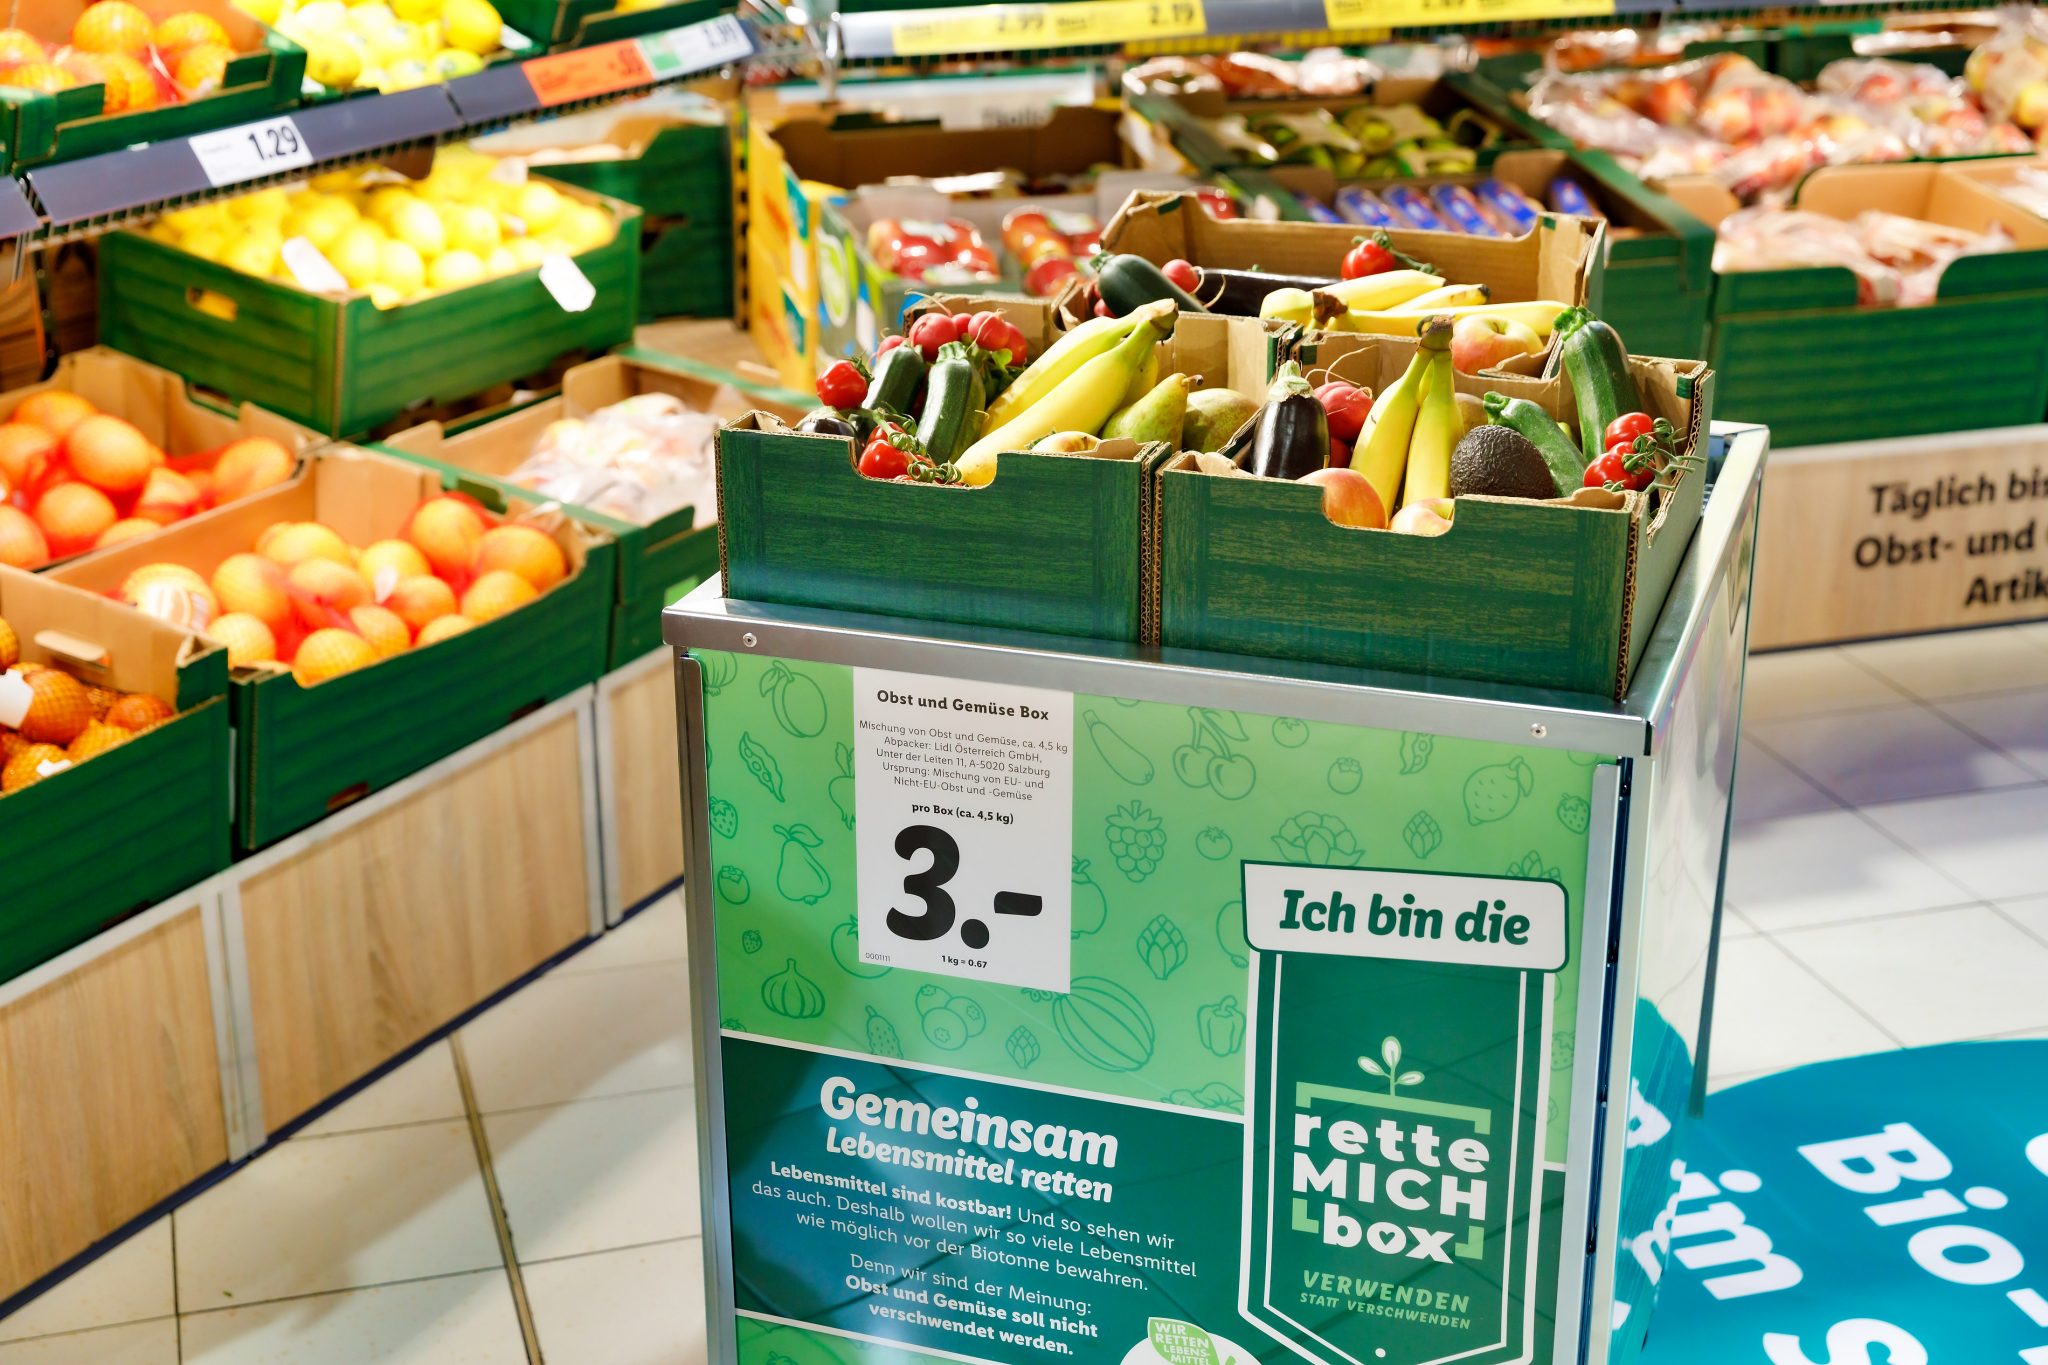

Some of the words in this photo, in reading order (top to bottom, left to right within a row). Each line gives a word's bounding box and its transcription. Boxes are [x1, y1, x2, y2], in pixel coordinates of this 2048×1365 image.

[248, 126, 298, 160] 1.29
[1871, 474, 1995, 519] Täglich
[1854, 533, 1955, 569] Obst-
[1967, 518, 2036, 556] und
[877, 690, 913, 706] Obst
[918, 697, 948, 710] und
[952, 698, 1015, 717] Gemüse
[1020, 705, 1048, 720] Box
[859, 720, 906, 736] Mischung
[908, 728, 926, 736] von
[929, 728, 952, 739] Obst
[955, 733, 974, 742] und
[977, 733, 1020, 747] Gemüse,
[1022, 740, 1036, 749] ca.
[1038, 741, 1053, 751] 4,5
[1056, 742, 1068, 754] kg
[884, 736, 931, 750] Abpacker:
[934, 742, 952, 752] Lidl
[954, 742, 1005, 758] Österreich
[876, 747, 902, 760] Unter
[905, 752, 921, 762] der
[924, 754, 953, 765] Leiten
[956, 757, 967, 768] 11,
[969, 759, 1005, 771] A-5020
[1008, 763, 1050, 779] Salzburg
[882, 761, 930, 778] Ursprung:
[933, 768, 980, 784] Mischung
[983, 776, 1001, 784] von
[1004, 776, 1021, 786] EU-
[1025, 780, 1044, 789] und
[894, 776, 964, 793] Nicht-EU-Obst
[966, 787, 986, 796] und
[989, 788, 1032, 801] -Gemüse
[912, 804, 930, 813] pro
[933, 805, 953, 816] Box
[956, 807, 975, 818] (ca.
[977, 811, 993, 821] 4,5
[996, 812, 1014, 824] kg)
[1279, 889, 1356, 933] Ich
[1368, 893, 1443, 939] bin
[1455, 899, 1530, 945] die
[948, 956, 959, 966] kg
[968, 959, 987, 968] 0.67
[820, 1076, 1118, 1168] Gemeinsam
[1294, 1113, 1490, 1173] rette
[827, 1127, 1014, 1185] Lebensmittel
[1021, 1168, 1112, 1203] retten
[1293, 1152, 1487, 1221] MICH
[771, 1161, 887, 1196] Lebensmittel
[892, 1184, 931, 1205] sind
[936, 1192, 1011, 1220] kostbar!
[1018, 1207, 1055, 1228] Und
[1061, 1219, 1081, 1232] so
[1087, 1223, 1140, 1243] sehen
[1147, 1234, 1175, 1249] wir
[752, 1180, 781, 1198] das
[787, 1190, 831, 1207] auch.
[836, 1195, 905, 1222] Deshalb
[910, 1214, 967, 1234] wollen
[973, 1225, 1000, 1240] wir
[1006, 1231, 1026, 1244] so
[1032, 1235, 1073, 1253] viele
[1080, 1241, 1197, 1277] Lebensmittel
[1323, 1202, 1455, 1264] box
[797, 1213, 825, 1228] wie
[831, 1220, 898, 1243] möglich
[903, 1235, 931, 1249] vor
[936, 1238, 964, 1256] der
[970, 1243, 1049, 1272] Biotonne
[1056, 1259, 1148, 1290] bewahren.
[845, 1275, 889, 1297] Obst
[893, 1287, 929, 1304] und
[933, 1293, 1007, 1320] Gemüse
[1012, 1311, 1045, 1328] soll
[1049, 1316, 1098, 1338] nicht
[850, 1253, 895, 1279] Denn
[900, 1267, 927, 1282] wir
[932, 1272, 969, 1291] sind
[974, 1279, 1003, 1297] der
[1009, 1285, 1091, 1316] Meinung:
[1304, 1270, 1469, 1313] VERWENDEN
[868, 1304, 996, 1340] verschwendet
[999, 1331, 1073, 1355] werden.
[1155, 1322, 1186, 1335] WIR
[1300, 1292, 1340, 1308] STATT
[1347, 1300, 1470, 1329] VERSCHWENDEN
[1155, 1333, 1209, 1349] RETTEN
